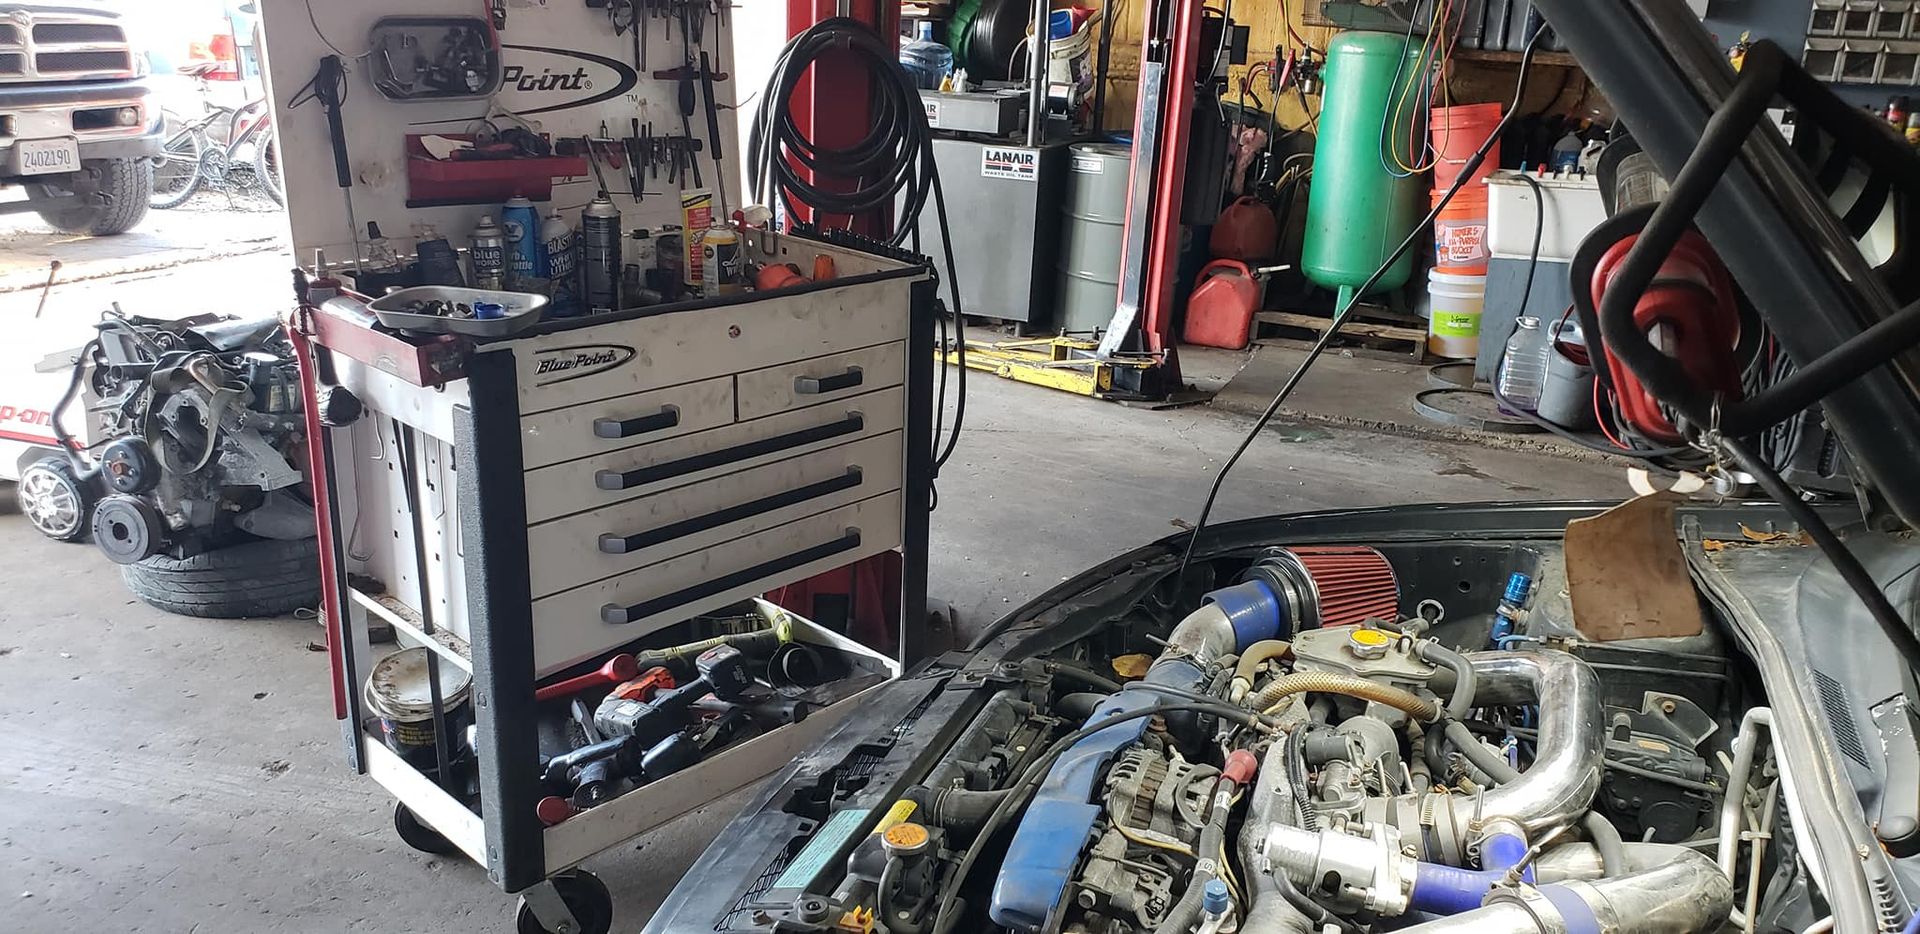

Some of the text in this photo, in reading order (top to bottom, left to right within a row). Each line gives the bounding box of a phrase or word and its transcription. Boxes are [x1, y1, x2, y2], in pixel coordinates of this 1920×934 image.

[24, 149, 71, 168] 2402190
[985, 150, 1034, 165] LANAIR
[474, 249, 501, 260] blue
[0, 406, 53, 426] p-on
